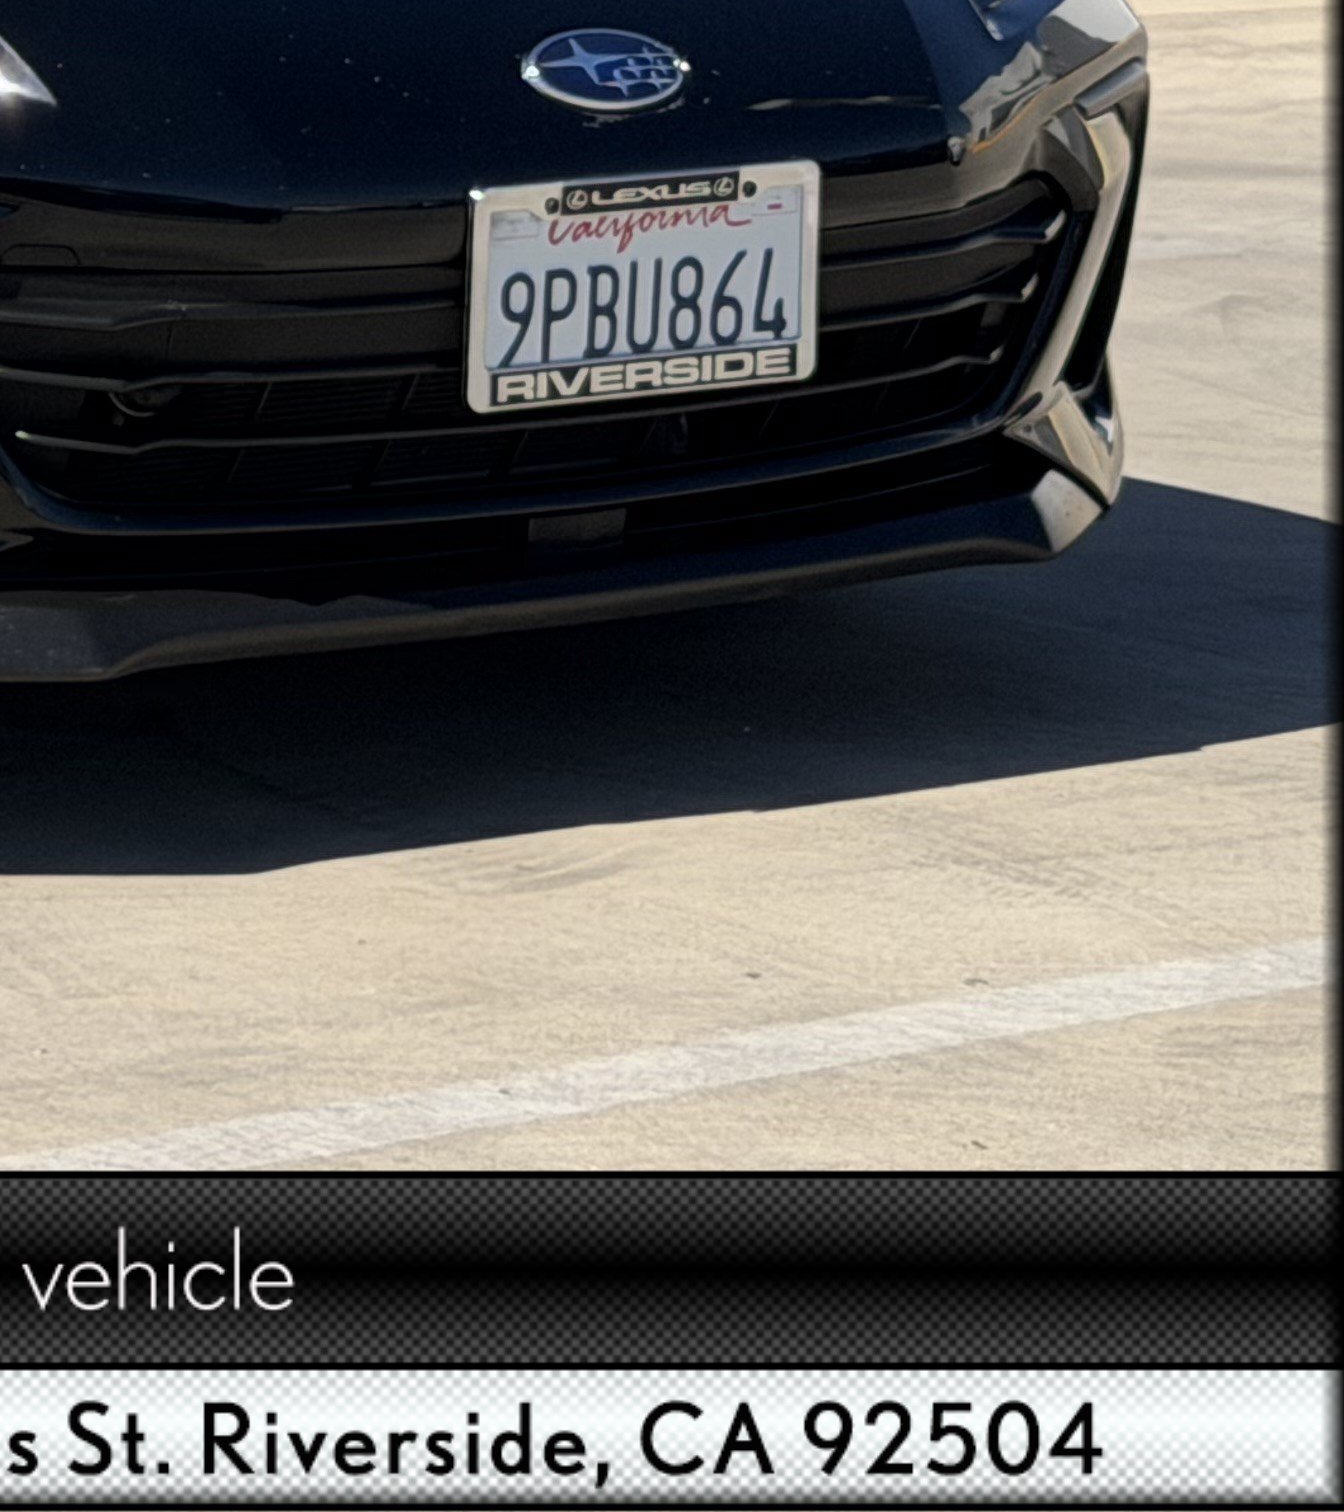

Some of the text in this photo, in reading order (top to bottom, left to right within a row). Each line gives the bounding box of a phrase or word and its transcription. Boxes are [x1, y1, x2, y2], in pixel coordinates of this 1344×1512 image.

[591, 180, 713, 206] LEXUS
[498, 248, 786, 368] 9PBU864
[497, 347, 791, 404] RIVERSIDE
